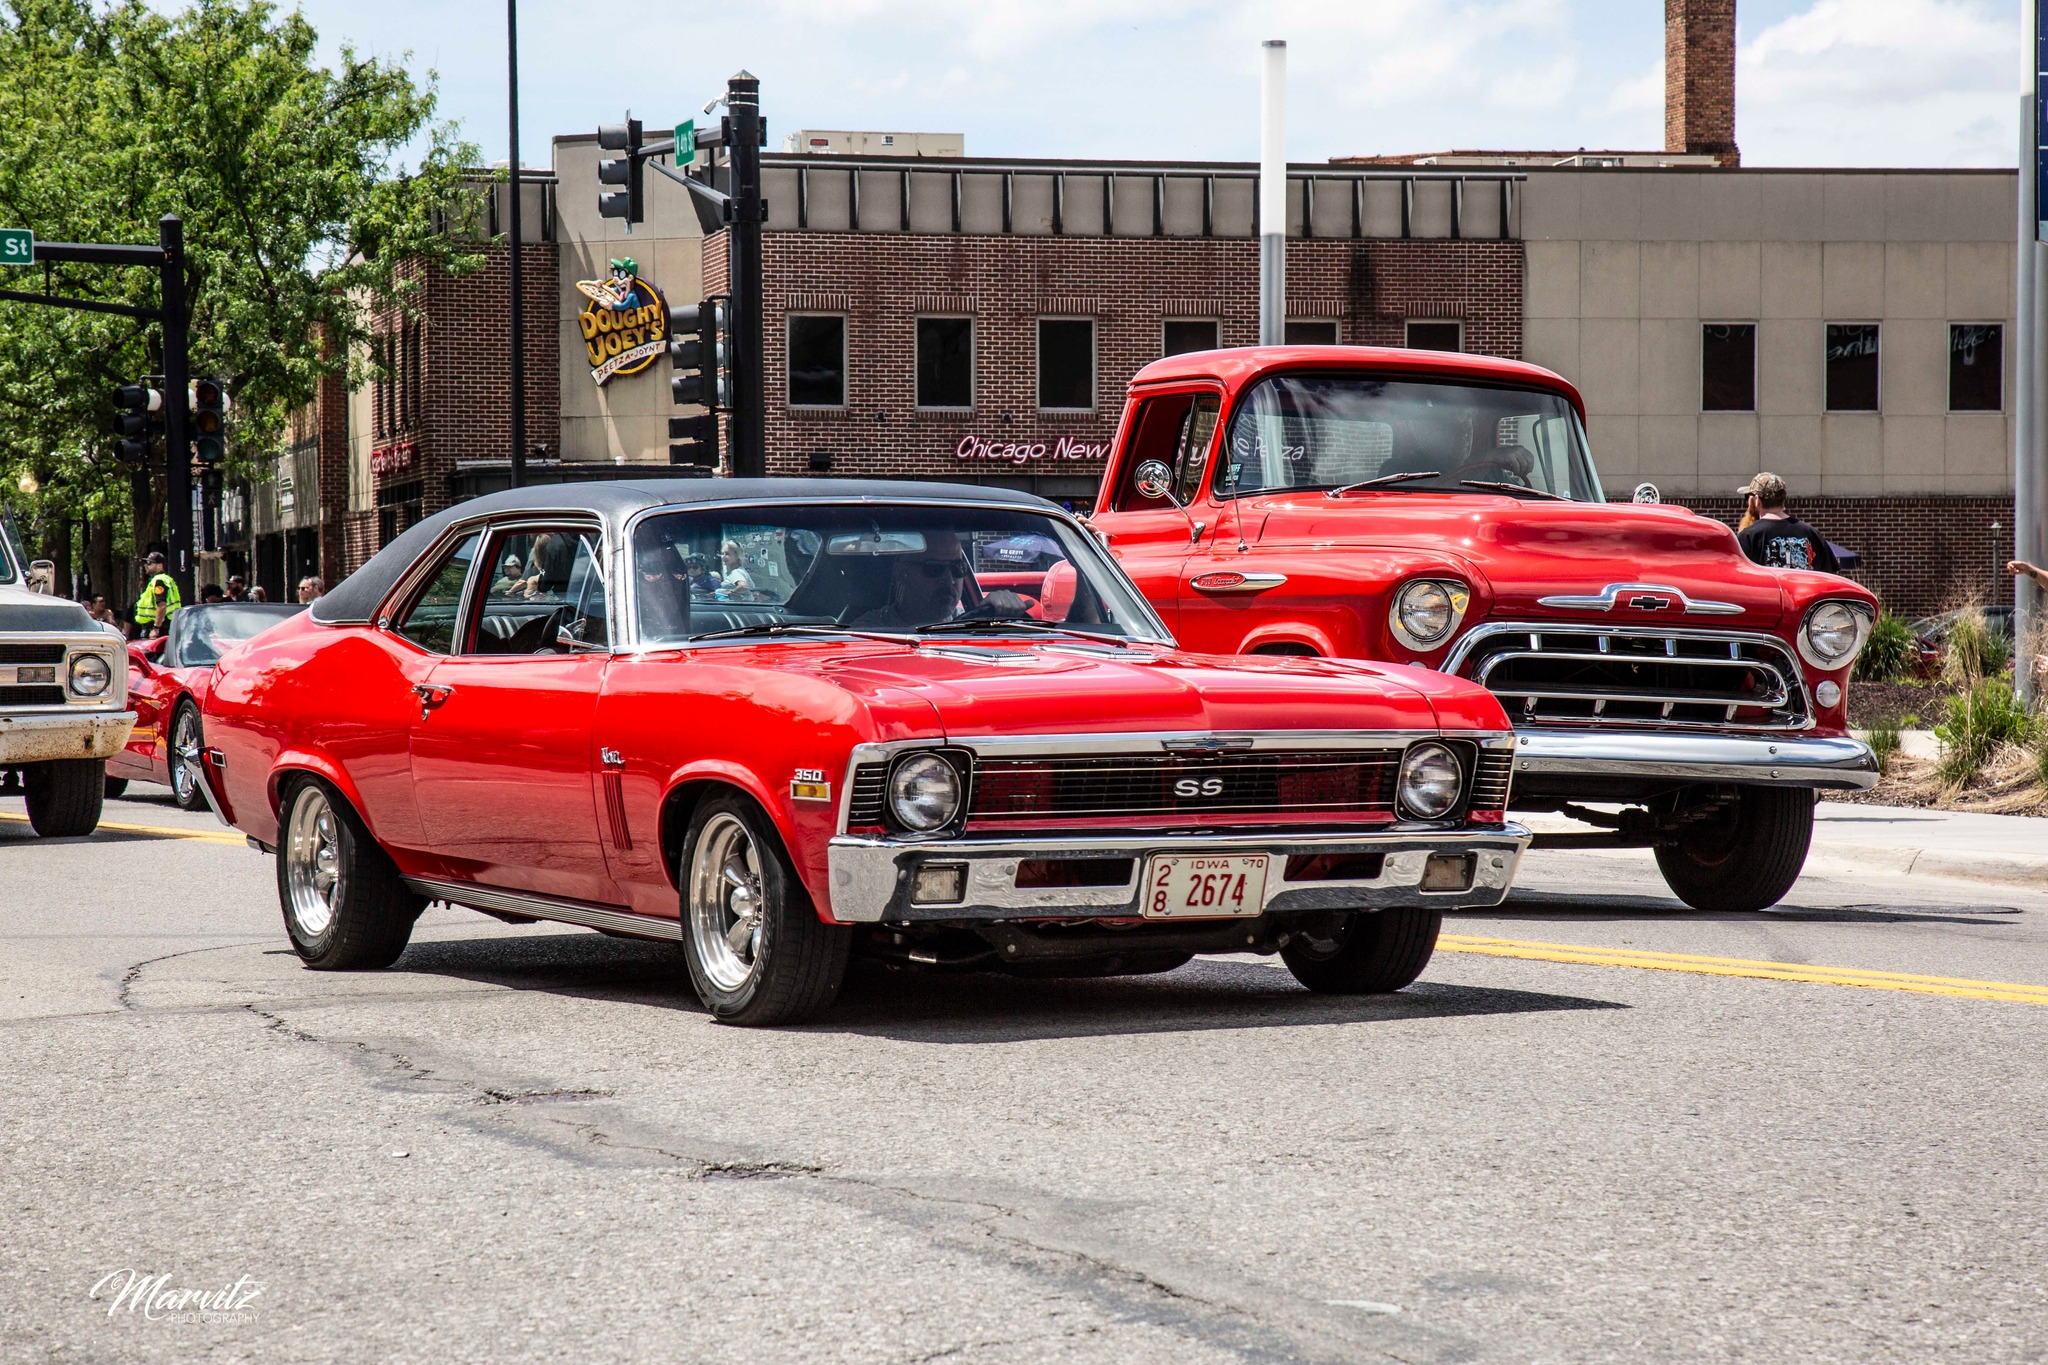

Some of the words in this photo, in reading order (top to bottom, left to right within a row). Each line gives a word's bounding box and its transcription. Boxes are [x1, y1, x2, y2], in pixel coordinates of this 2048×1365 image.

[5, 237, 28, 256] St
[578, 301, 662, 340] DOUGHY
[588, 321, 664, 366] JOEY'S
[596, 343, 661, 379] PEETZA-JOYNT
[957, 436, 1046, 464] Chicago
[1053, 437, 1110, 459] New
[794, 768, 824, 781] 350
[1174, 778, 1223, 797] SS
[1156, 864, 1171, 887] 2
[1190, 860, 1230, 870] IOWA
[1185, 873, 1246, 906] 2674
[1152, 890, 1167, 913] 8
